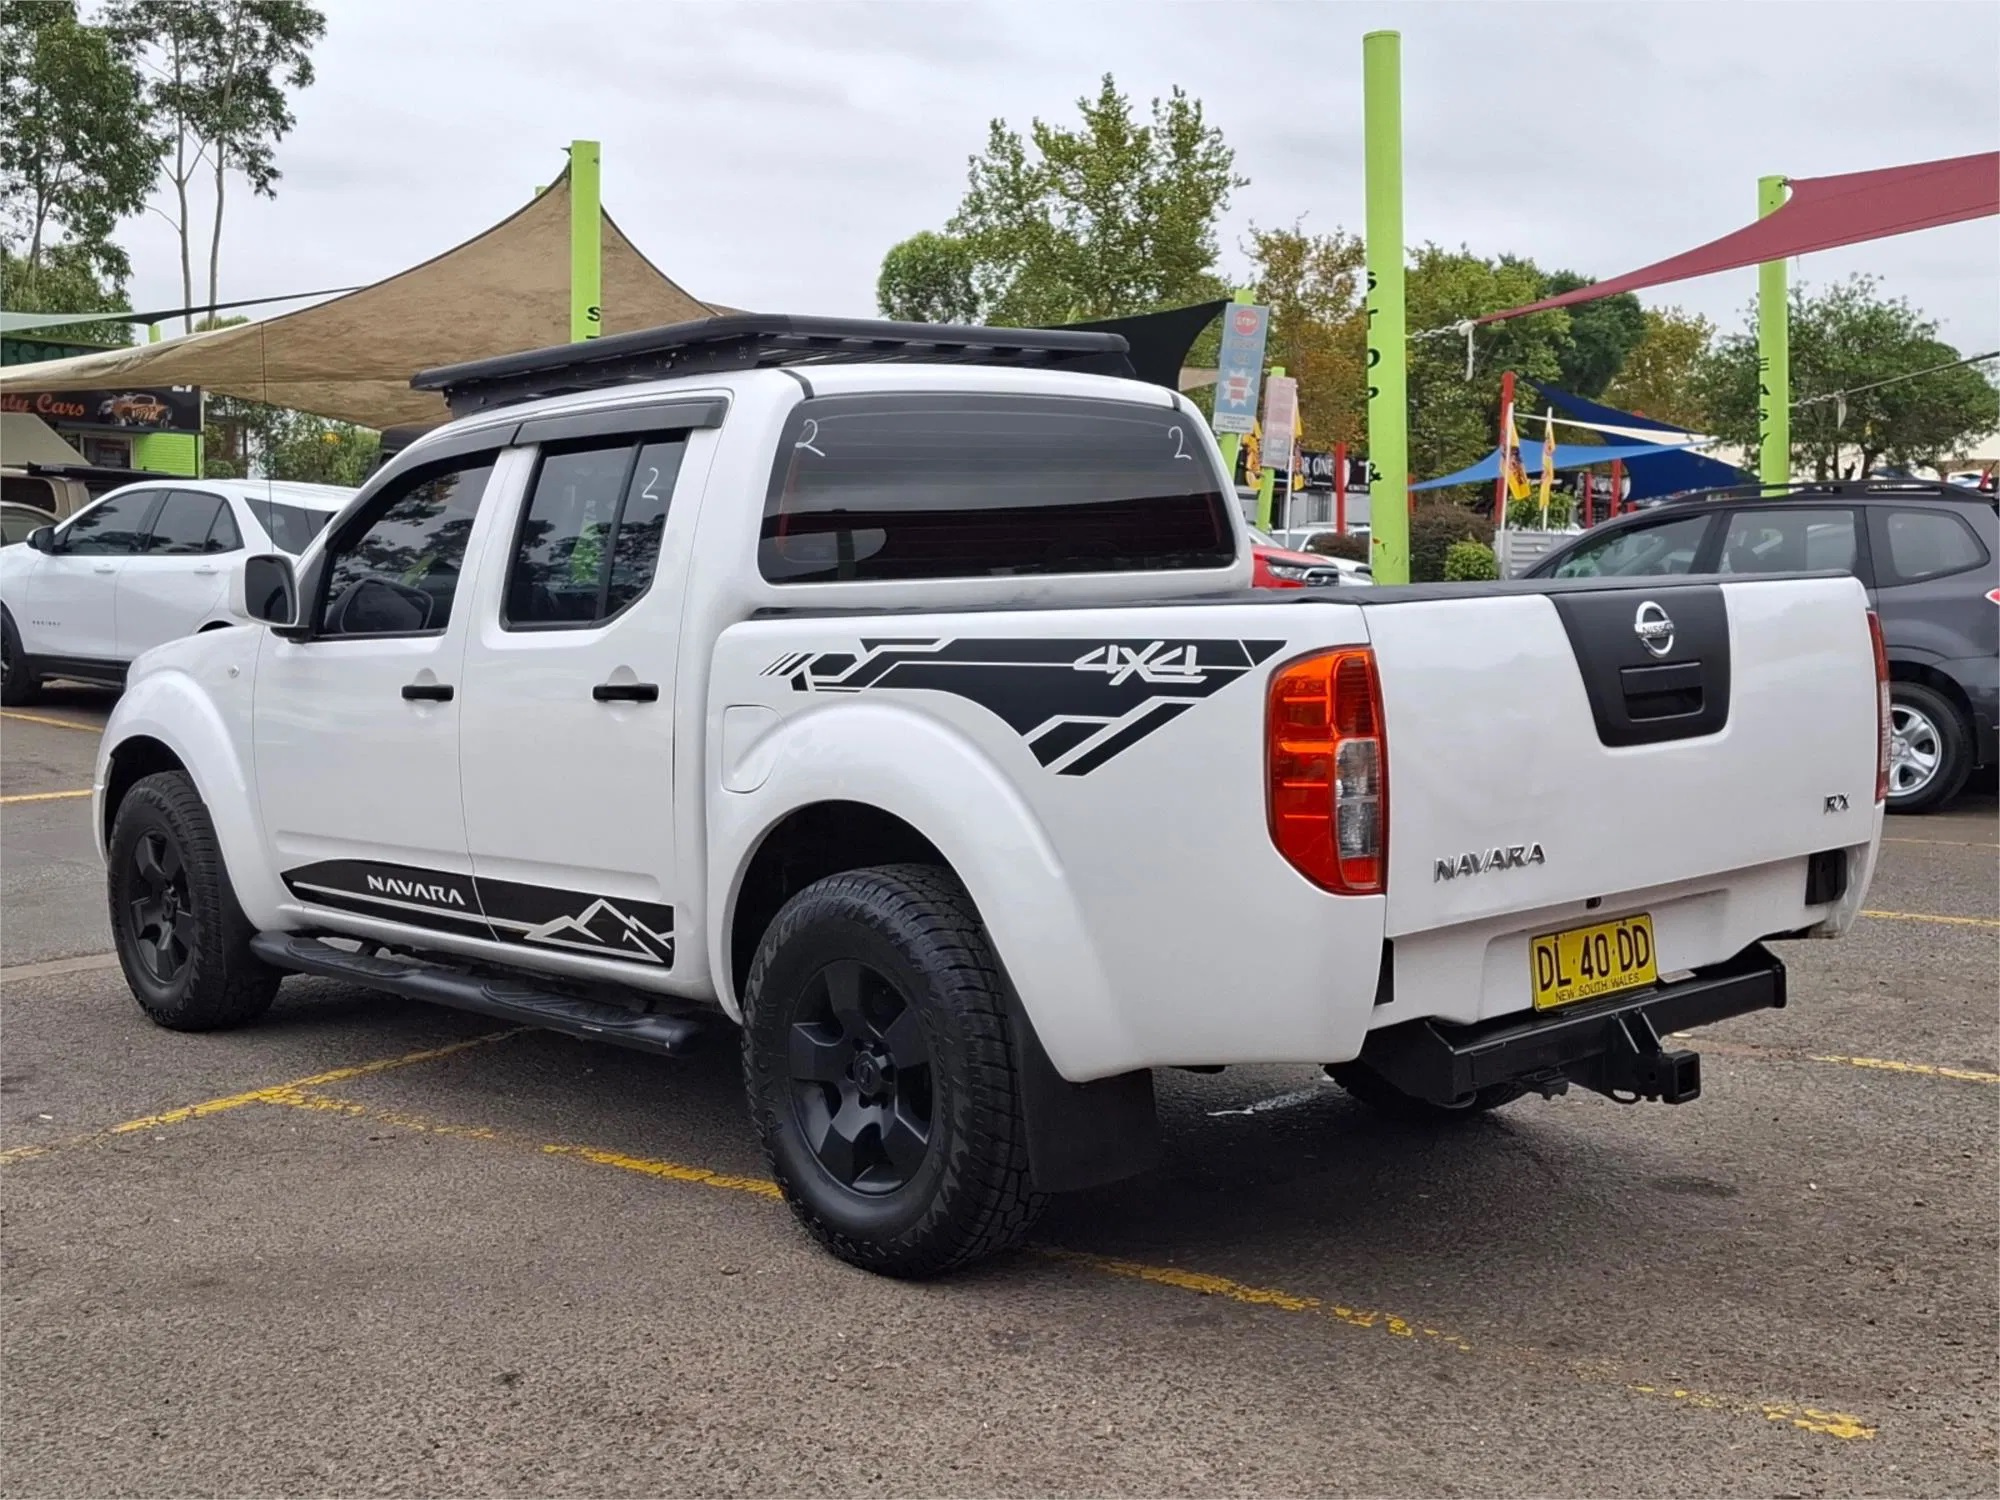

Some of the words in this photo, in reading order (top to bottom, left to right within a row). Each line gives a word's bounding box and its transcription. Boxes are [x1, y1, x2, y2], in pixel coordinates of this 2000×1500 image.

[1235, 316, 1257, 327] STOP
[37, 393, 84, 416] Cars
[795, 418, 826, 457] 2
[1168, 425, 1192, 460] 2
[641, 467, 659, 500] 2
[1823, 792, 1850, 815] RX
[1434, 842, 1546, 884] NAVARA
[366, 874, 466, 906] NAVARA
[1537, 942, 1572, 992] DL
[1581, 933, 1611, 980] 40
[1616, 924, 1650, 972] DD
[1555, 987, 1576, 1002] NEW
[1579, 980, 1609, 996] SOUTH
[1610, 972, 1640, 989] WALES
